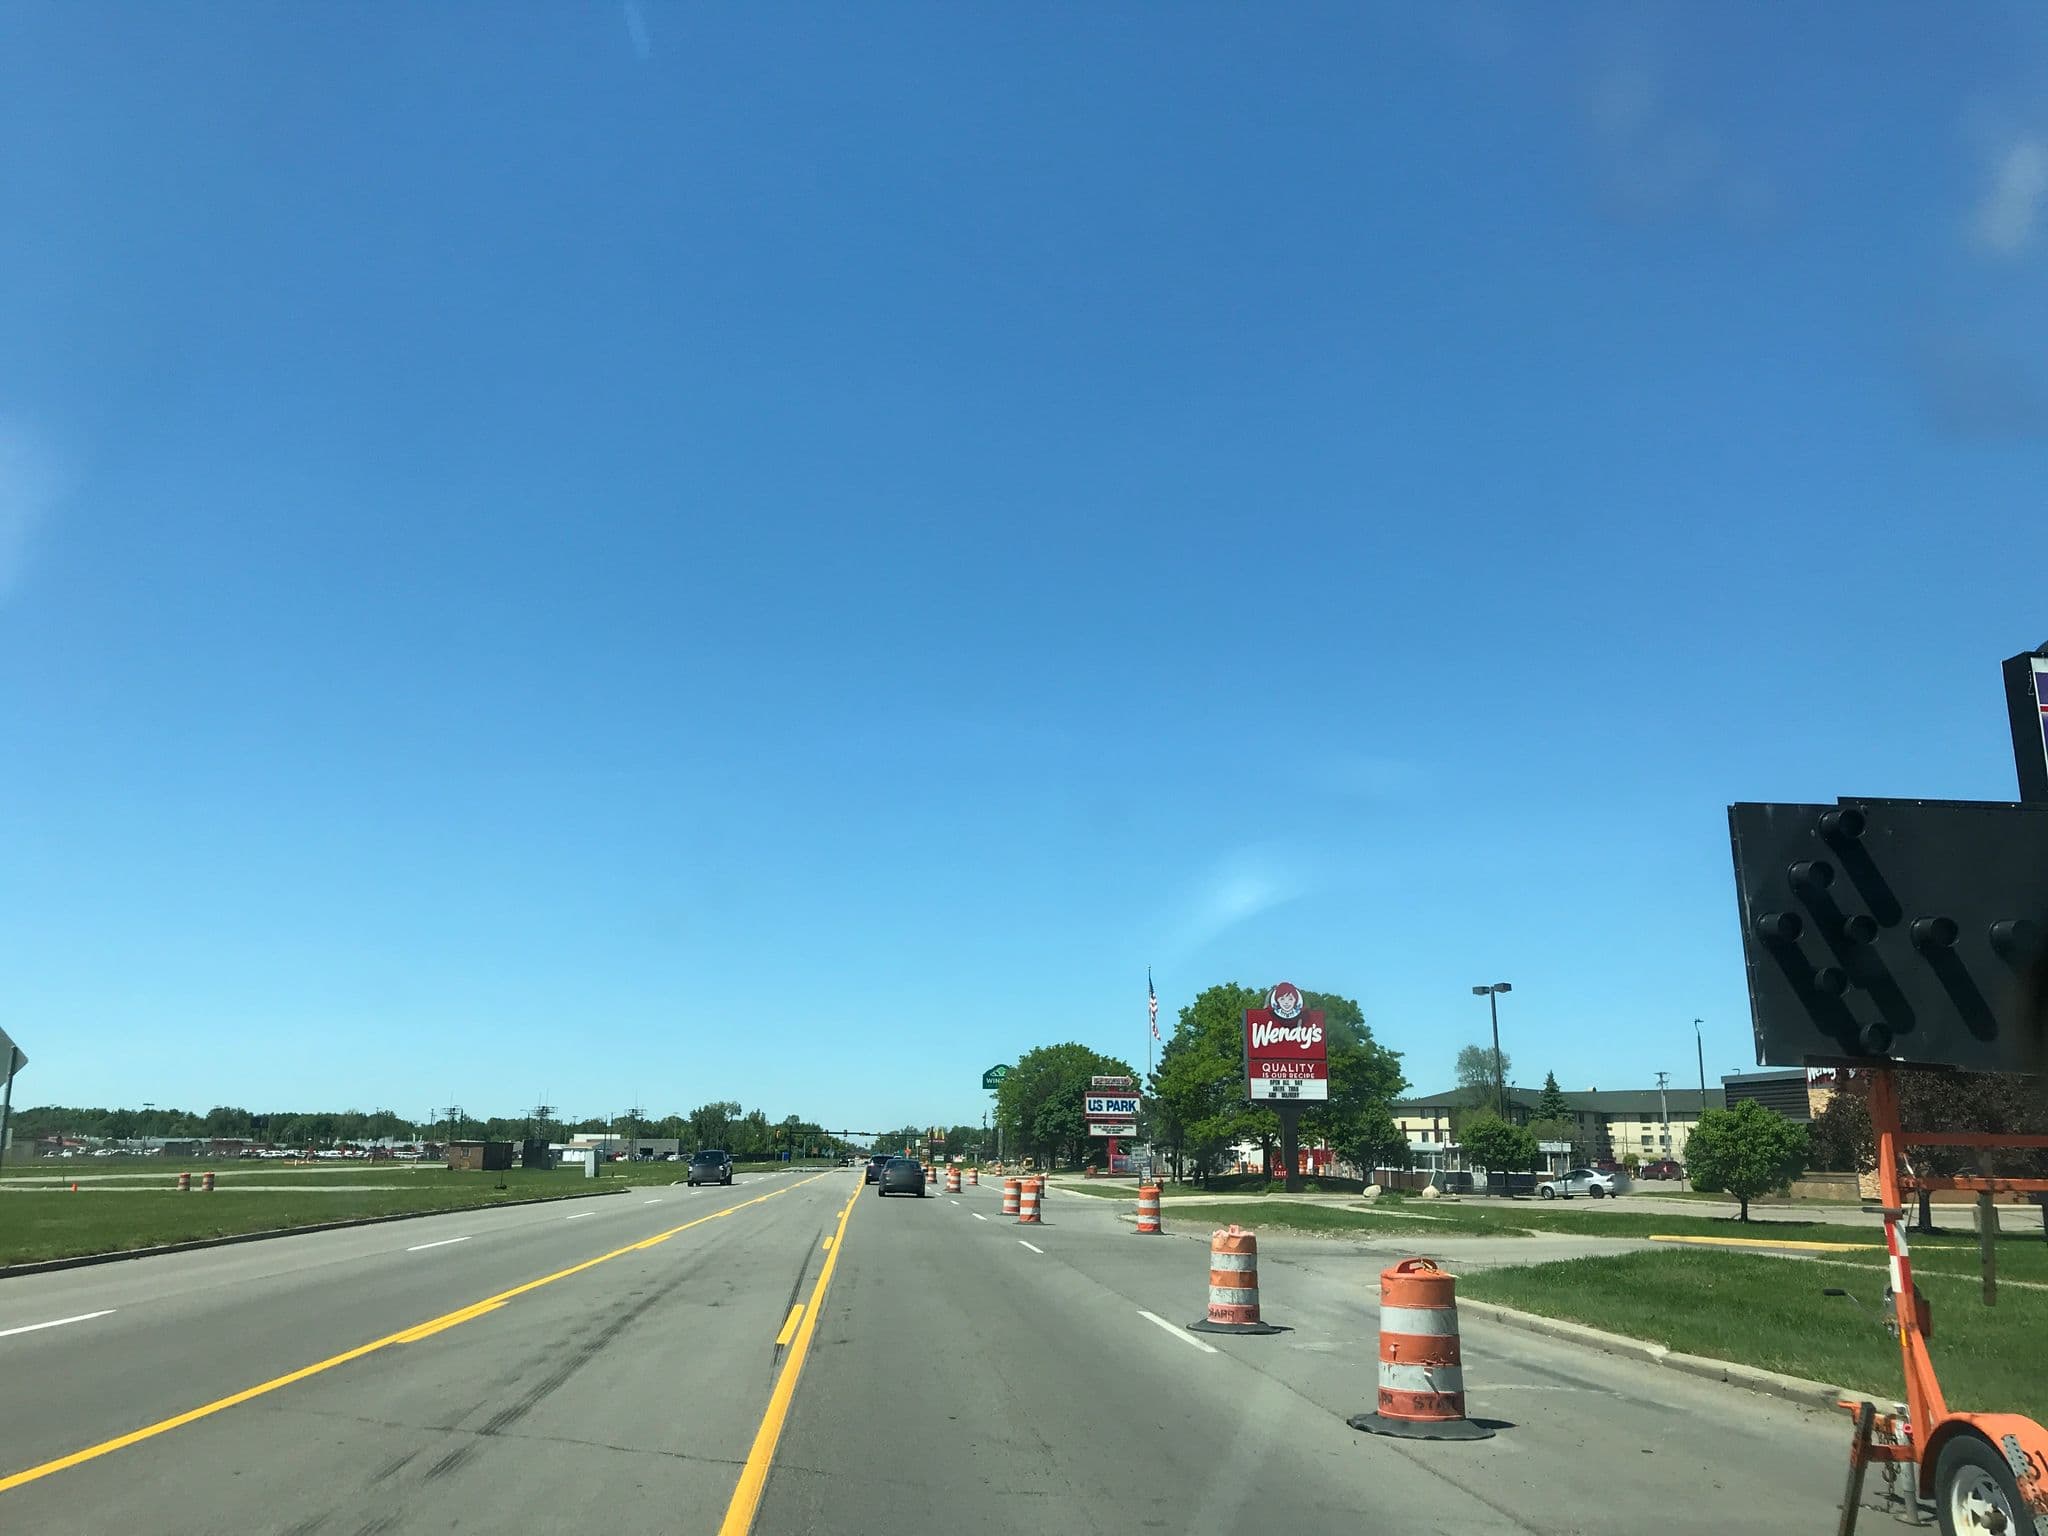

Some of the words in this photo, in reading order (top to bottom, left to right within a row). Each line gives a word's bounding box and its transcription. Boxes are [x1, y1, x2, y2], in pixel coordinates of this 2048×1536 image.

[1252, 1019, 1323, 1049] Wendy's
[1262, 1063, 1315, 1073] QUALITY
[1088, 1099, 1103, 1112] US
[1106, 1099, 1137, 1112] PARK
